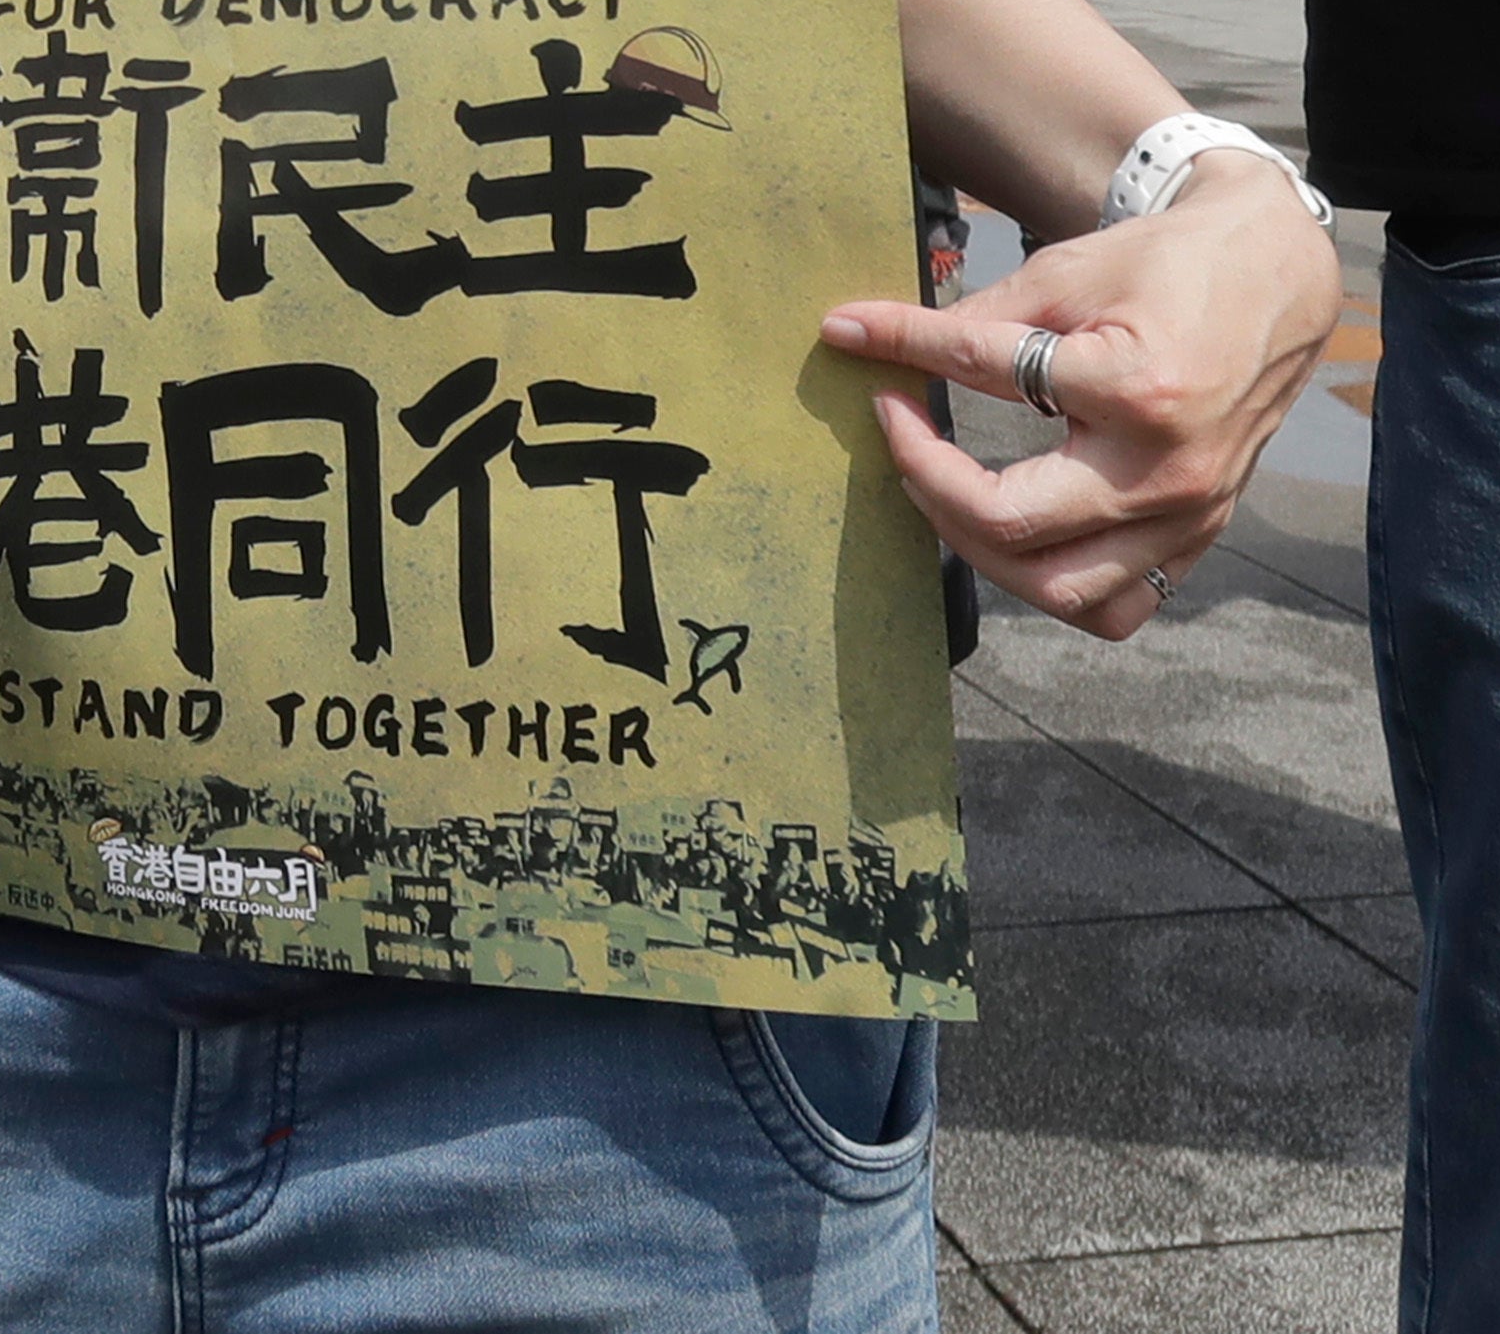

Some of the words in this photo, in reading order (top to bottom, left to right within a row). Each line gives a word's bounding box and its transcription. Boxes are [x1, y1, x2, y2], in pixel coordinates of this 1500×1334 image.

[0, 677, 219, 742] STAND
[271, 693, 656, 768] TOGETHER
[97, 837, 316, 911] 香港自由六月
[107, 883, 186, 906] HONGKONG
[201, 898, 274, 917] FREEDOM
[275, 906, 315, 921] JUNE
